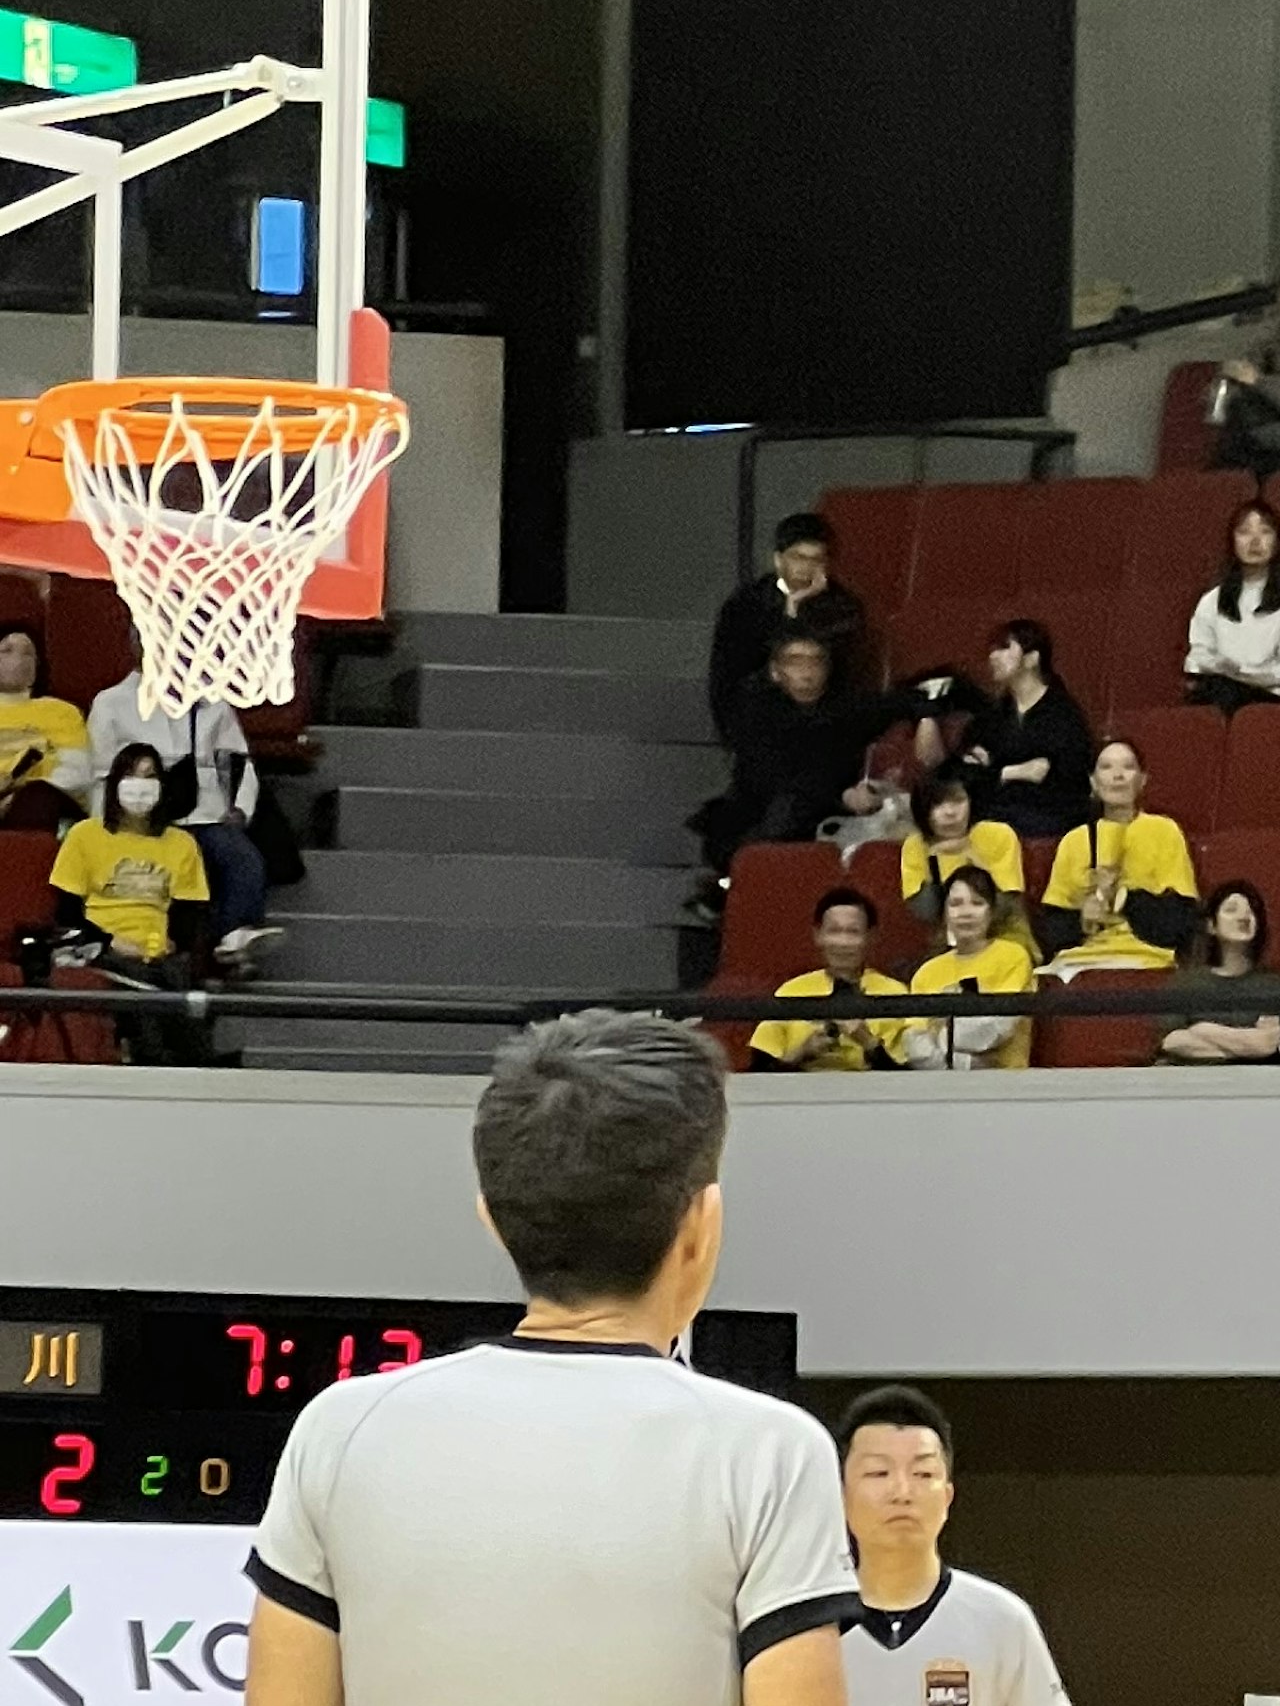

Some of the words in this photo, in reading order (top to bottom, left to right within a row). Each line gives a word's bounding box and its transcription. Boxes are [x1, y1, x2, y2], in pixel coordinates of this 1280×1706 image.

[23, 1332, 80, 1387] 川
[41, 1434, 96, 1515] 2
[141, 1455, 169, 1496] 2
[200, 1457, 231, 1496] 0
